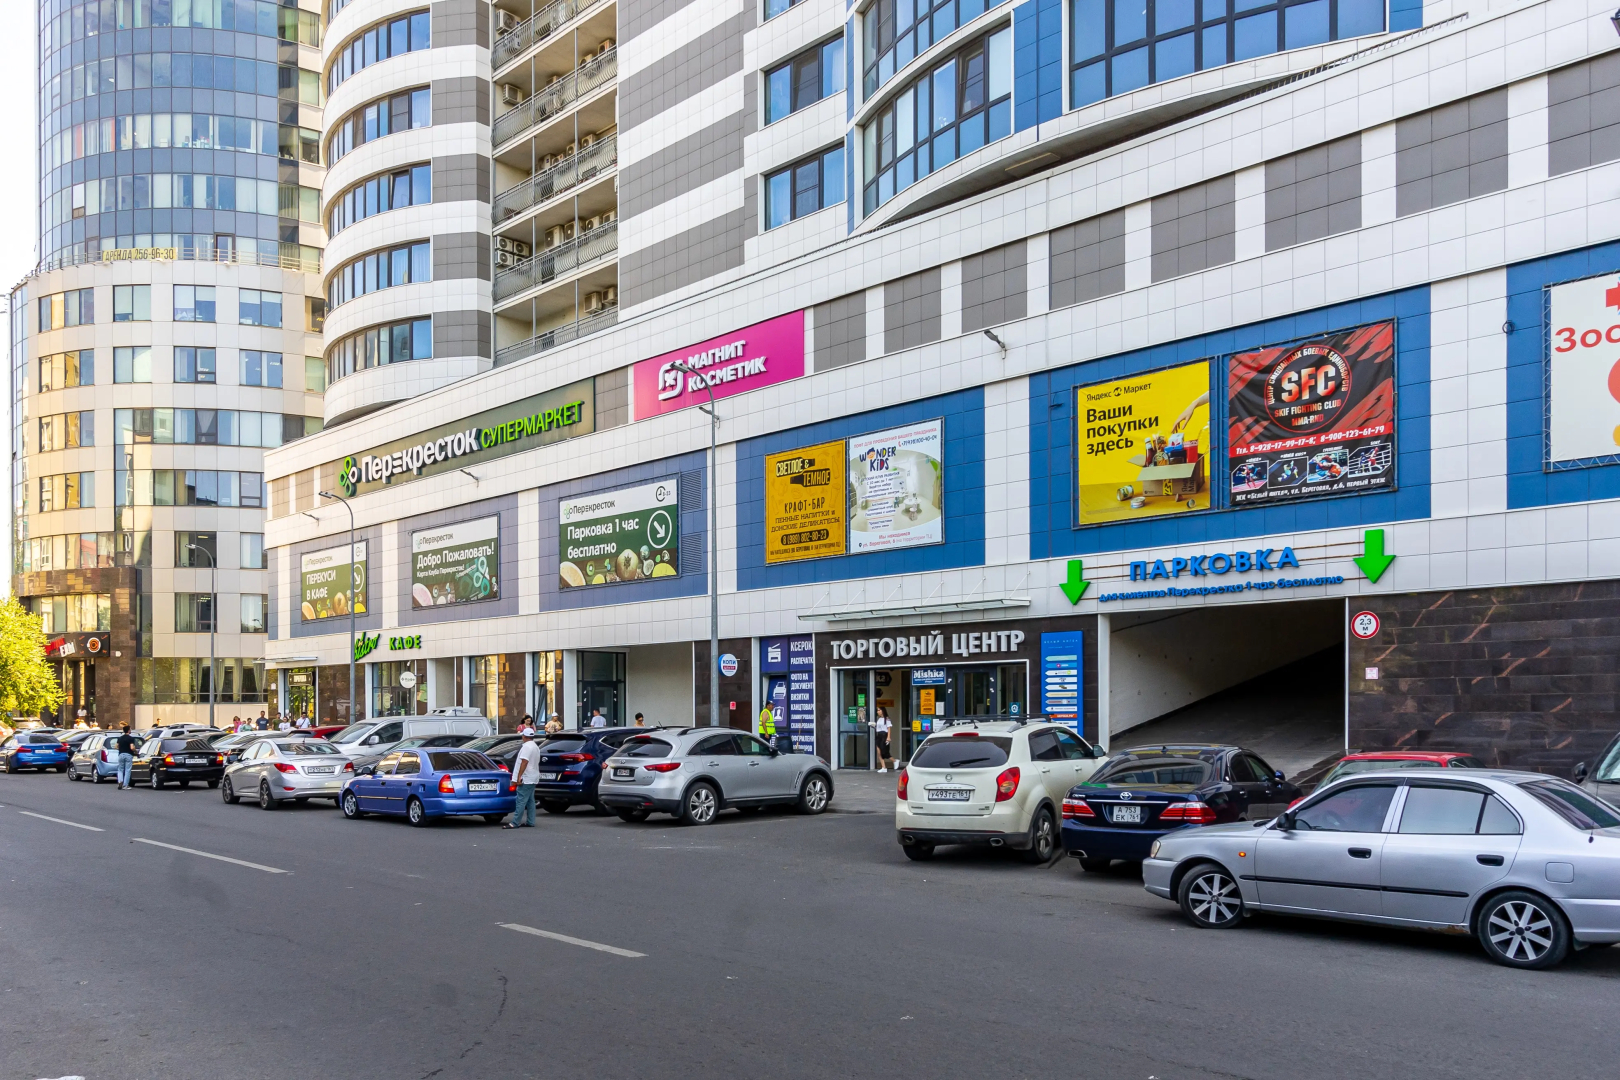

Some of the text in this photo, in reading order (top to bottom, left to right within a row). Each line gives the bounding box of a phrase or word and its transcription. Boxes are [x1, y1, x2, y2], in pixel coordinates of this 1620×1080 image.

[105, 248, 174, 261] АРЕНДА 256-96-30
[688, 340, 746, 369] МАГНИТ
[1303, 347, 1330, 357] БОЕВЫХ
[688, 356, 767, 393] КОСМЕТИК
[1281, 364, 1336, 403] SFC
[1086, 382, 1152, 402] Яндекс Маркет
[1086, 404, 1133, 424] Ваши
[1274, 398, 1342, 418] SKIF FIGHTING CLUB
[1086, 415, 1159, 440] покупки
[1320, 425, 1385, 443] 8-900-123-61-79
[361, 400, 583, 483] Перекресток СУПЕРМАРКЕТ
[1086, 437, 1134, 457] здесь
[776, 458, 804, 477] СВЕТЛОЕ
[803, 470, 831, 487] ТЕМНОЕ
[573, 500, 616, 515] Перекресток
[567, 518, 640, 541] Парковка 1 час
[416, 541, 494, 569] Добро Пожаловать!
[567, 542, 617, 559] бесплатно
[1130, 546, 1299, 582] ПАРКОВКА
[306, 569, 336, 585] ПЕРЕКУСИ
[306, 587, 328, 600] В КАФЕ
[1119, 589, 1166, 600] клиентов
[1166, 583, 1244, 597] Перекрестка
[1245, 581, 1251, 590] 1
[1253, 580, 1275, 590] час
[1276, 575, 1344, 589] бесплатно
[1359, 618, 1372, 626] 2,3
[389, 635, 422, 650] КАФЕ
[830, 630, 1025, 660] ТОРГОВЫЙ ЦЕНТР
[790, 673, 802, 681] ФОТО
[913, 669, 945, 679] Mishka
[790, 693, 810, 701] ВИЗИТКИ
[1124, 806, 1137, 814] 753
